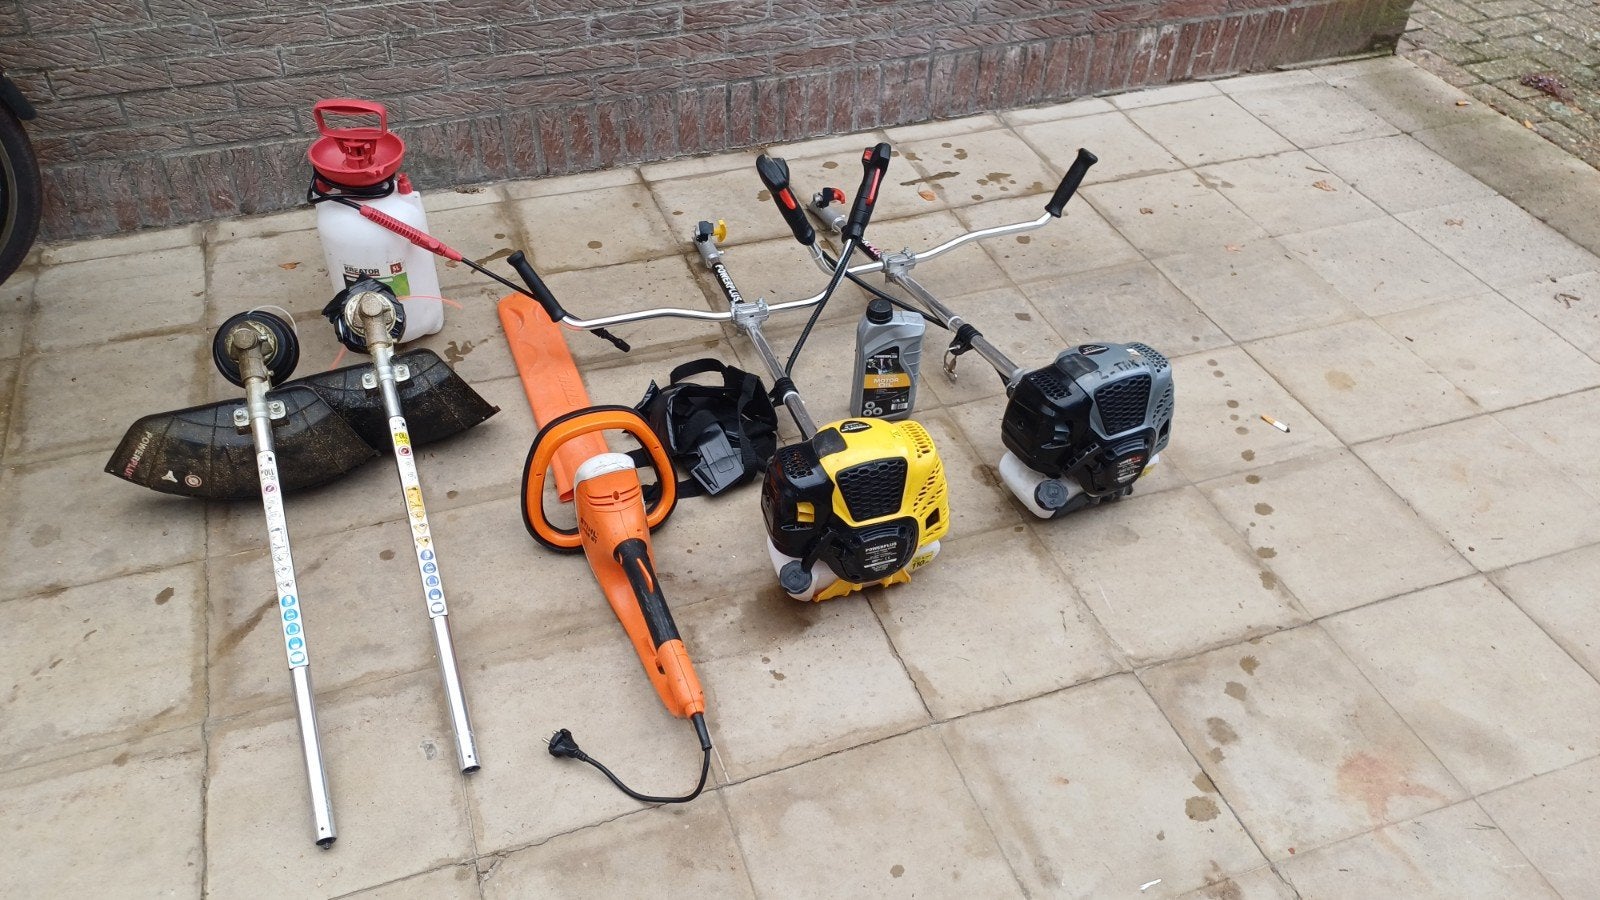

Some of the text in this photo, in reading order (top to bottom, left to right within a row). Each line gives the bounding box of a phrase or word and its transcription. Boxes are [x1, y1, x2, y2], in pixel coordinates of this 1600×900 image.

[344, 266, 380, 274] KREATOR
[714, 263, 743, 302] POWERPLUS
[865, 542, 897, 552] POWERPLUS
